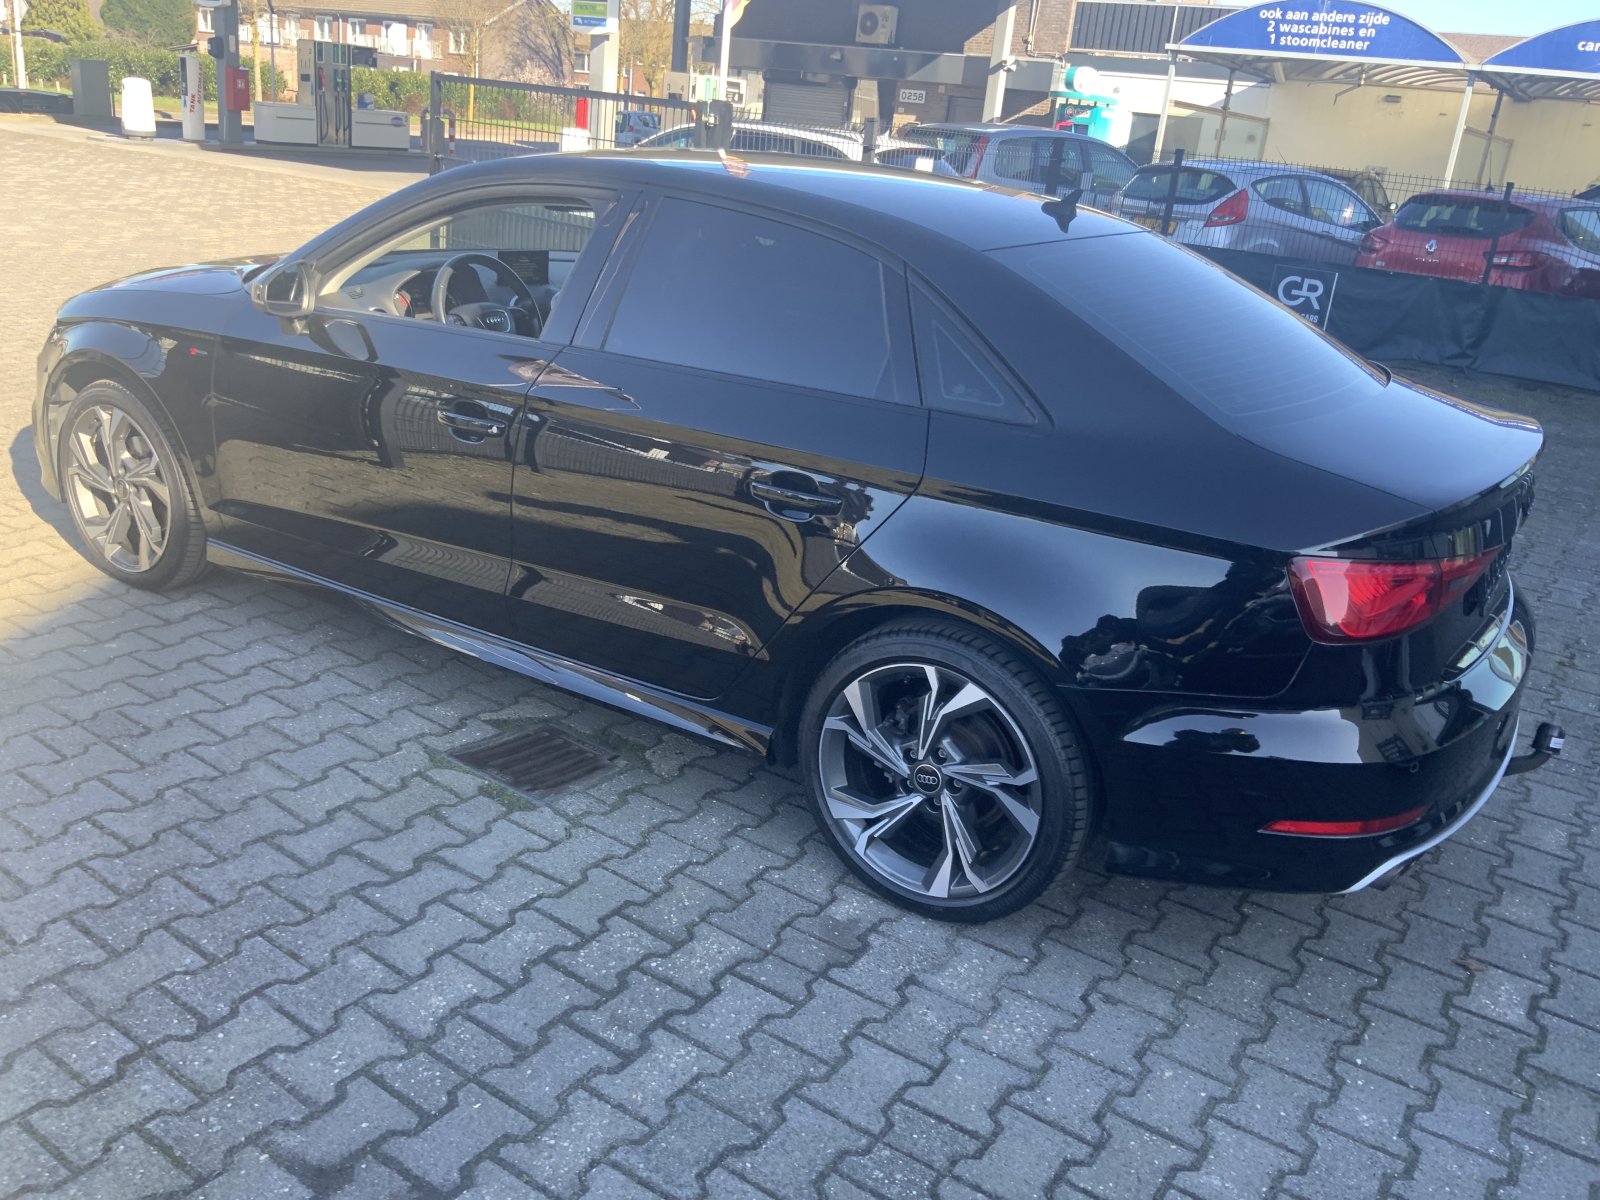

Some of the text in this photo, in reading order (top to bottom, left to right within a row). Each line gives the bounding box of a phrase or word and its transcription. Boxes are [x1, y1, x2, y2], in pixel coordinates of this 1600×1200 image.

[1260, 8, 1390, 26] ook aan andere zijde
[1267, 21, 1376, 37] 2 wascabines en
[1270, 34, 1370, 50] 1 stoomcleaner
[901, 91, 924, 101] 0258
[1278, 275, 1324, 310] GR
